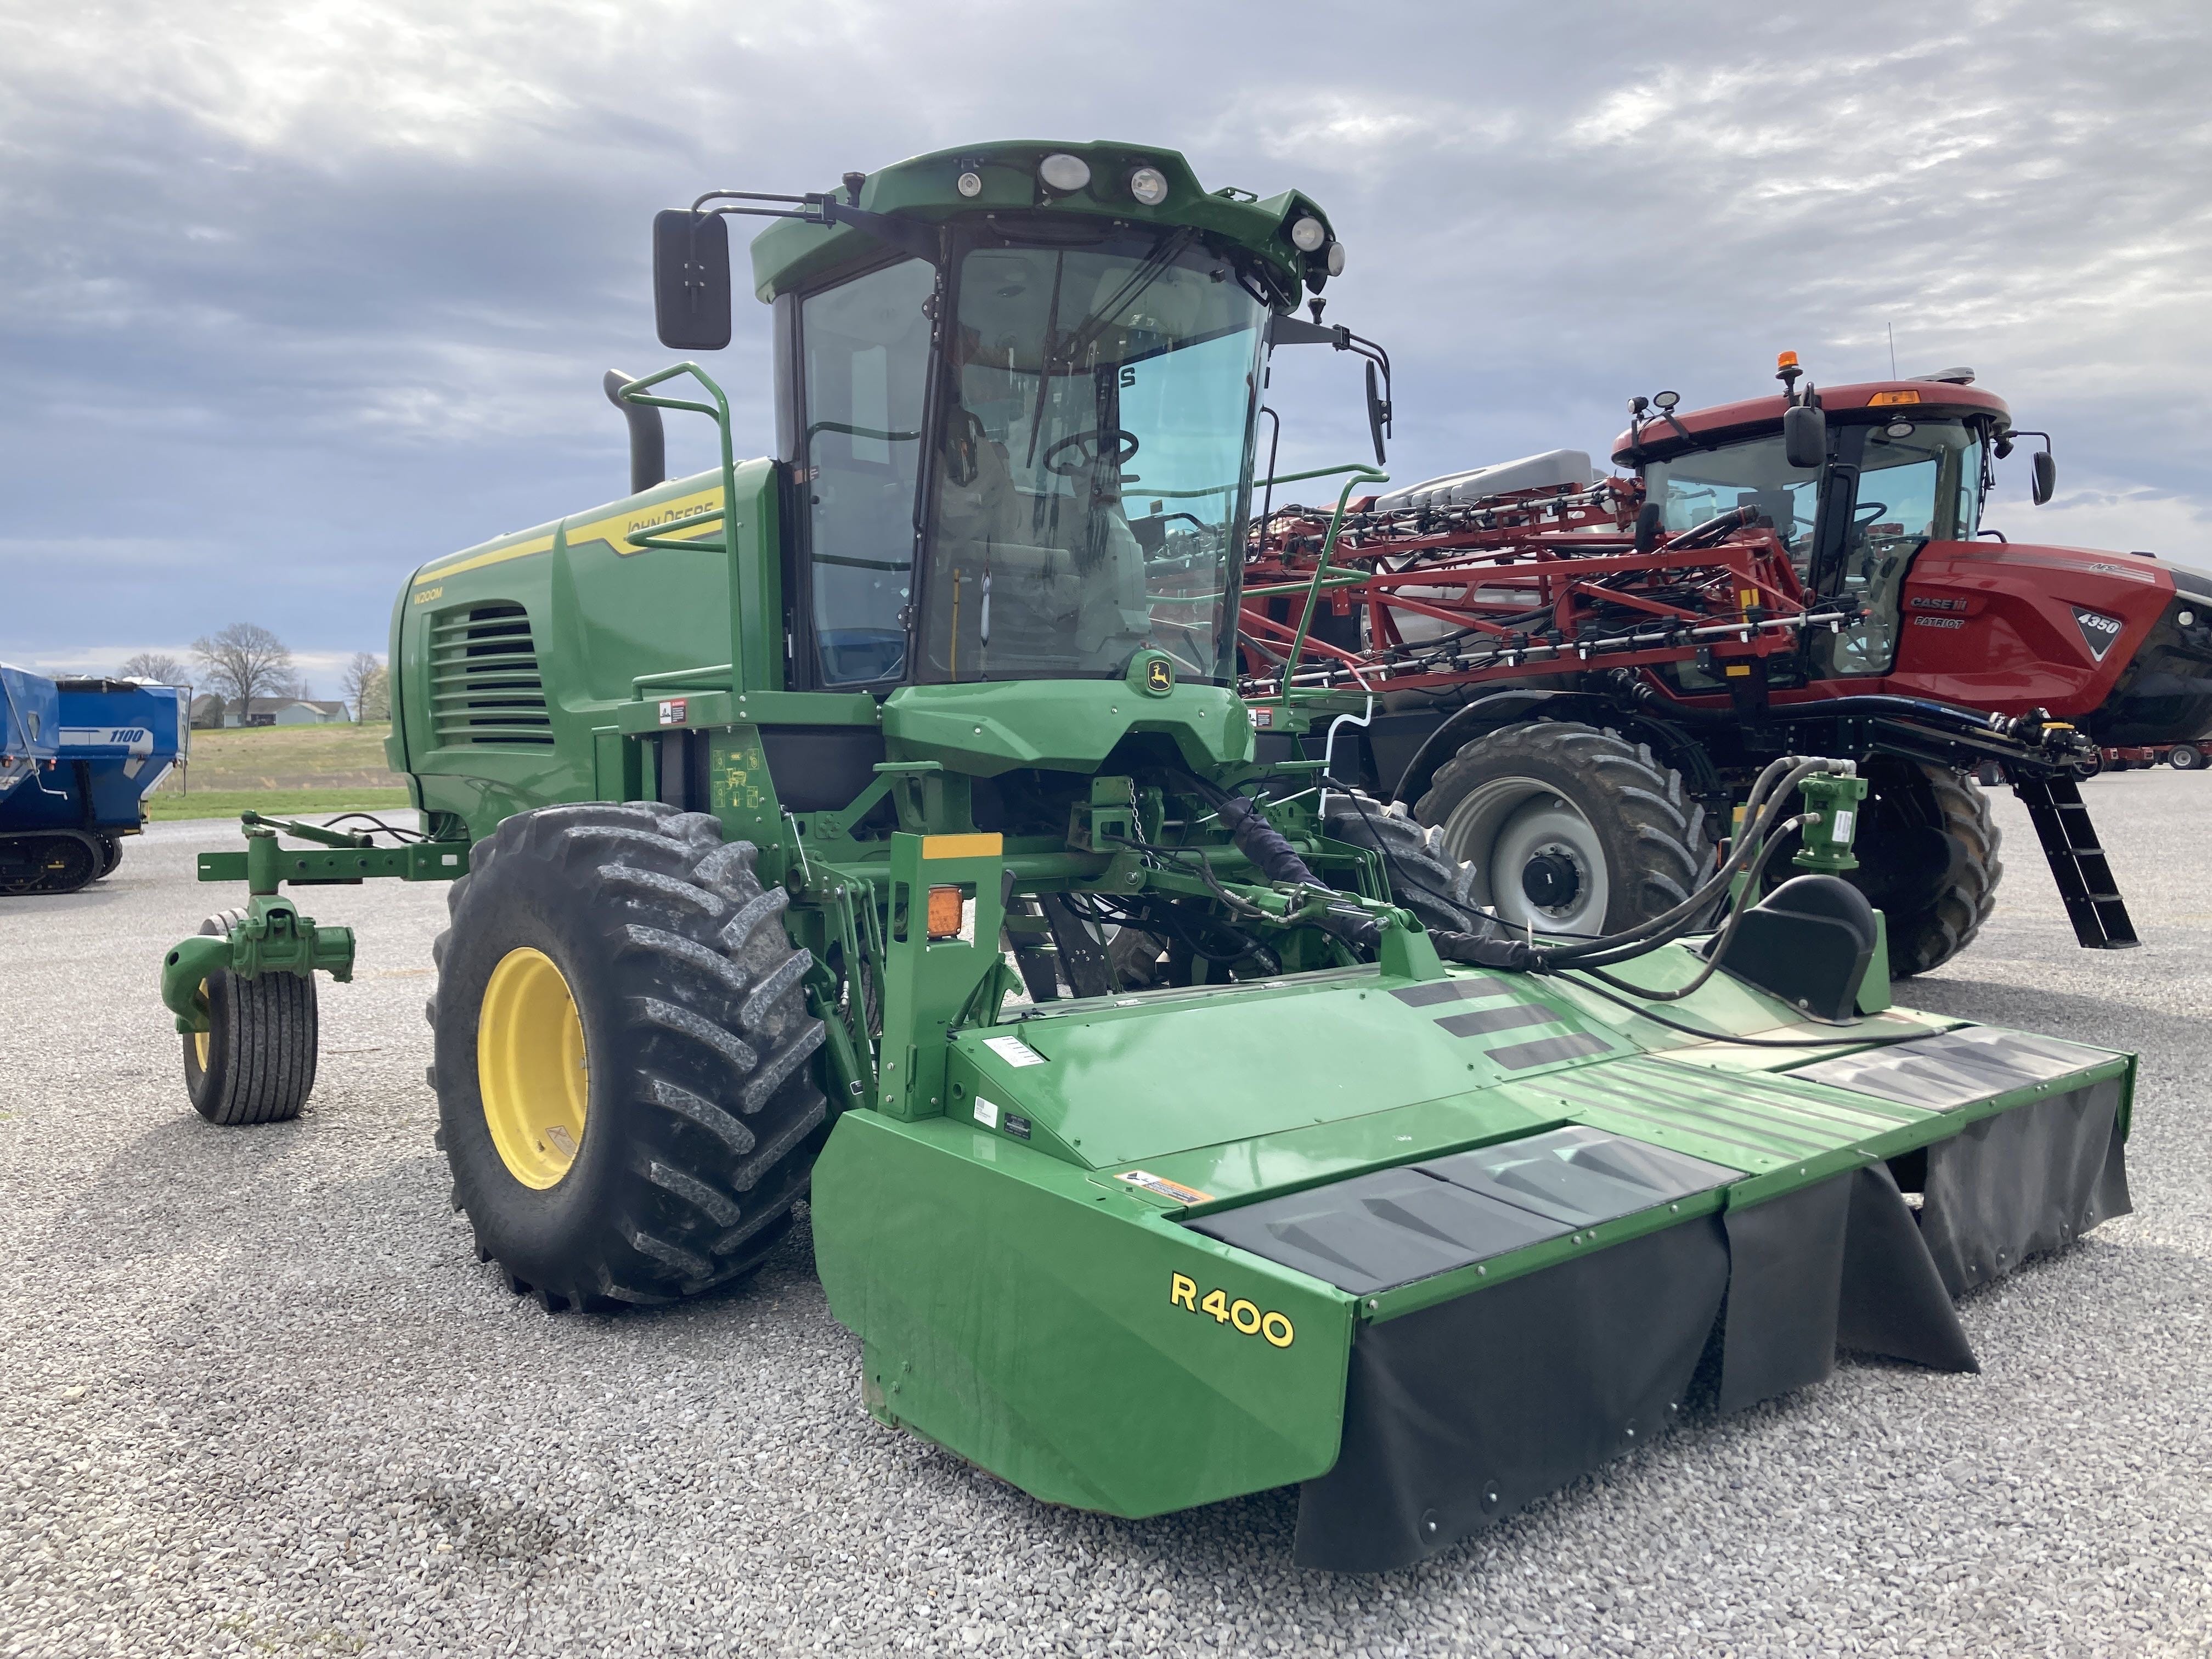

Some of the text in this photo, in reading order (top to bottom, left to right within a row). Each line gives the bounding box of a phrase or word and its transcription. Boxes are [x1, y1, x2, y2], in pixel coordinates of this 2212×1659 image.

[414, 586, 443, 605] W200M
[1911, 597, 1952, 610] CASE
[1914, 616, 1965, 629] PATRIOT
[2078, 613, 2121, 634] 4350
[110, 730, 144, 743] 1100
[1170, 1270, 1295, 1348] R400
